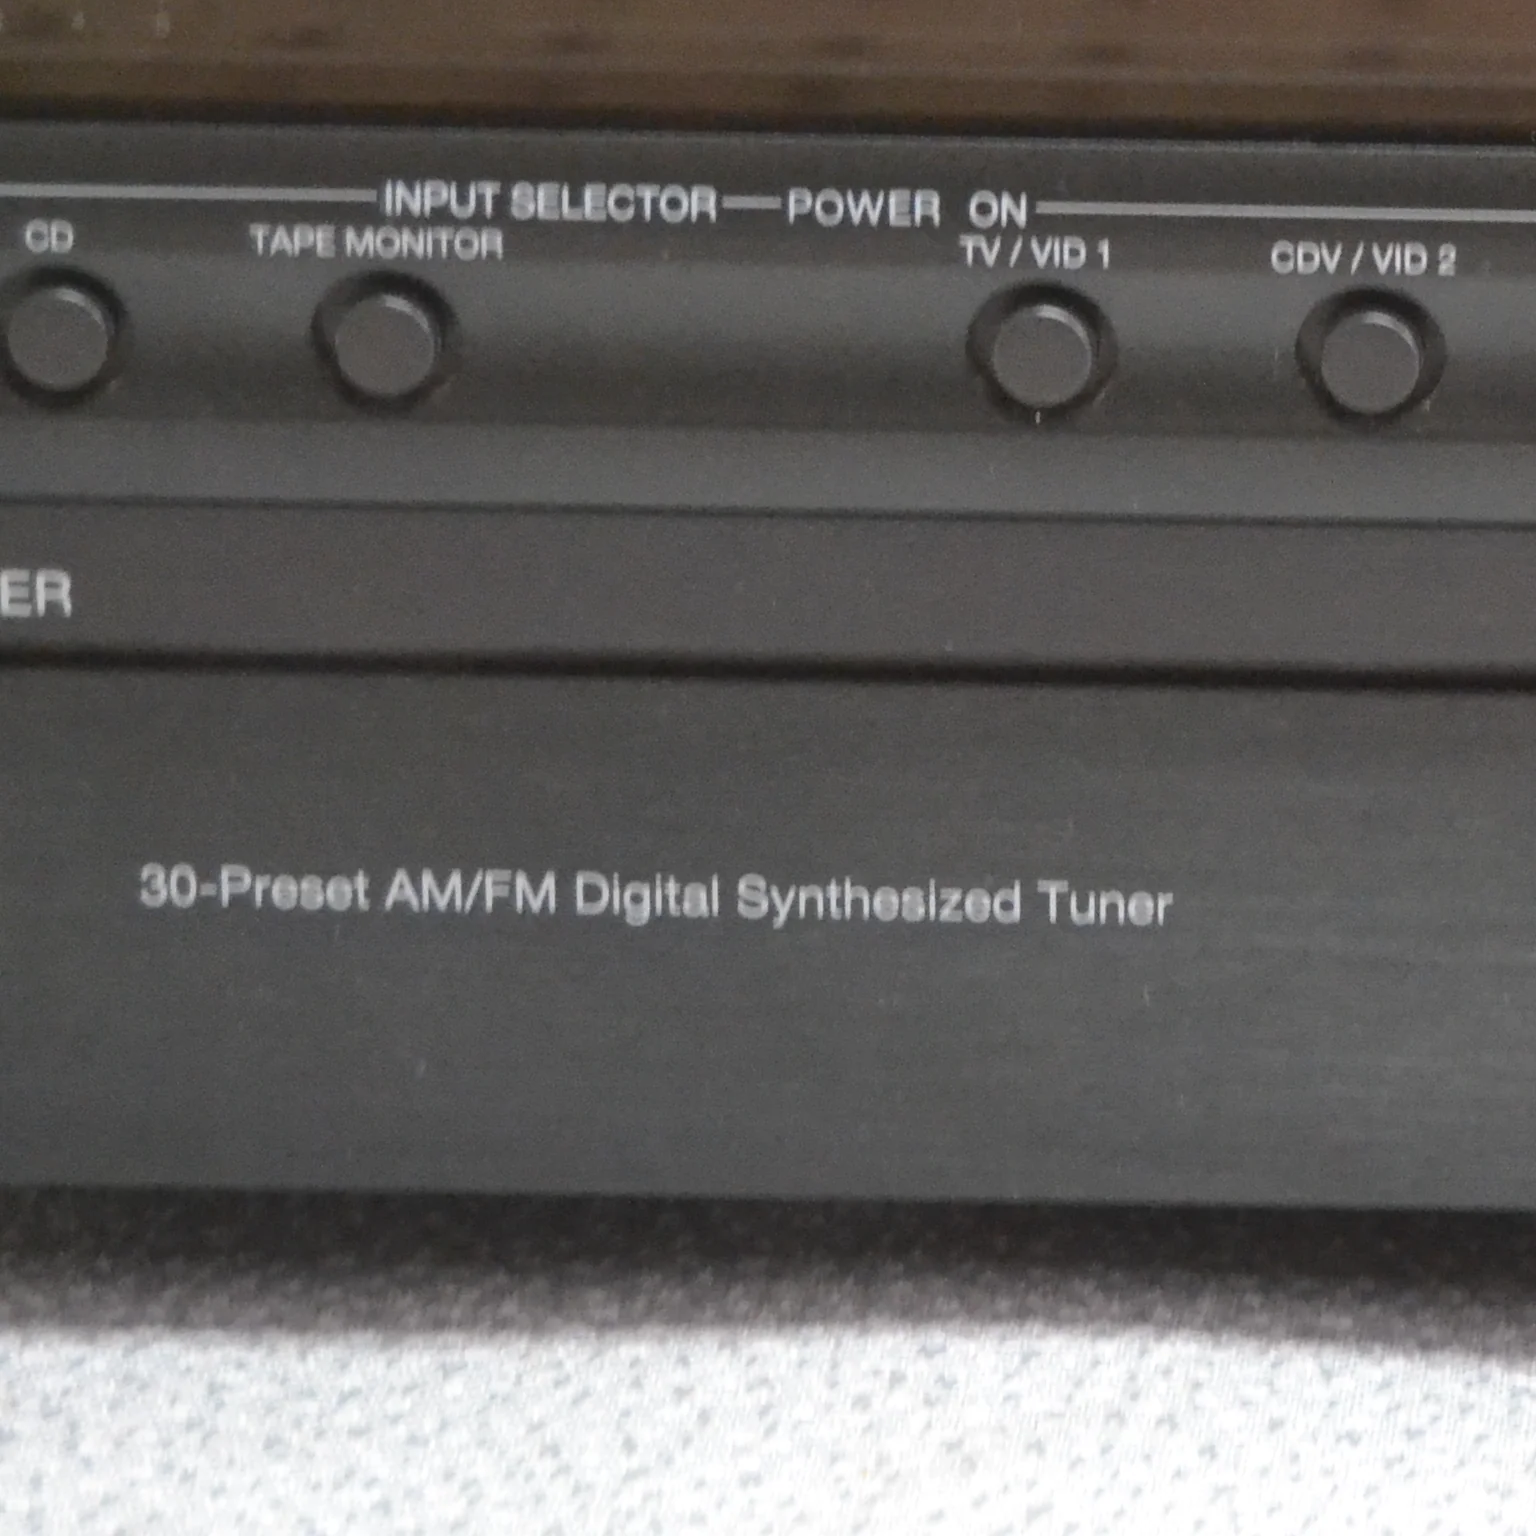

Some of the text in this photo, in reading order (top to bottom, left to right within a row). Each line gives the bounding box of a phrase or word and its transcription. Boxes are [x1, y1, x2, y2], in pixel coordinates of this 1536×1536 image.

[385, 180, 718, 224] INPUT SELECTOR
[786, 189, 1028, 231] POWER ON
[25, 218, 73, 254] CD
[250, 223, 504, 261] TAPE MONITOR
[960, 235, 1001, 267] TV
[1030, 237, 1089, 269] VID
[1271, 240, 1342, 275] CDV
[1372, 241, 1427, 276] VID
[1, 568, 72, 618] ER
[139, 866, 1174, 931] 30-Preset AM/FM Digital Synthesized Tuner
